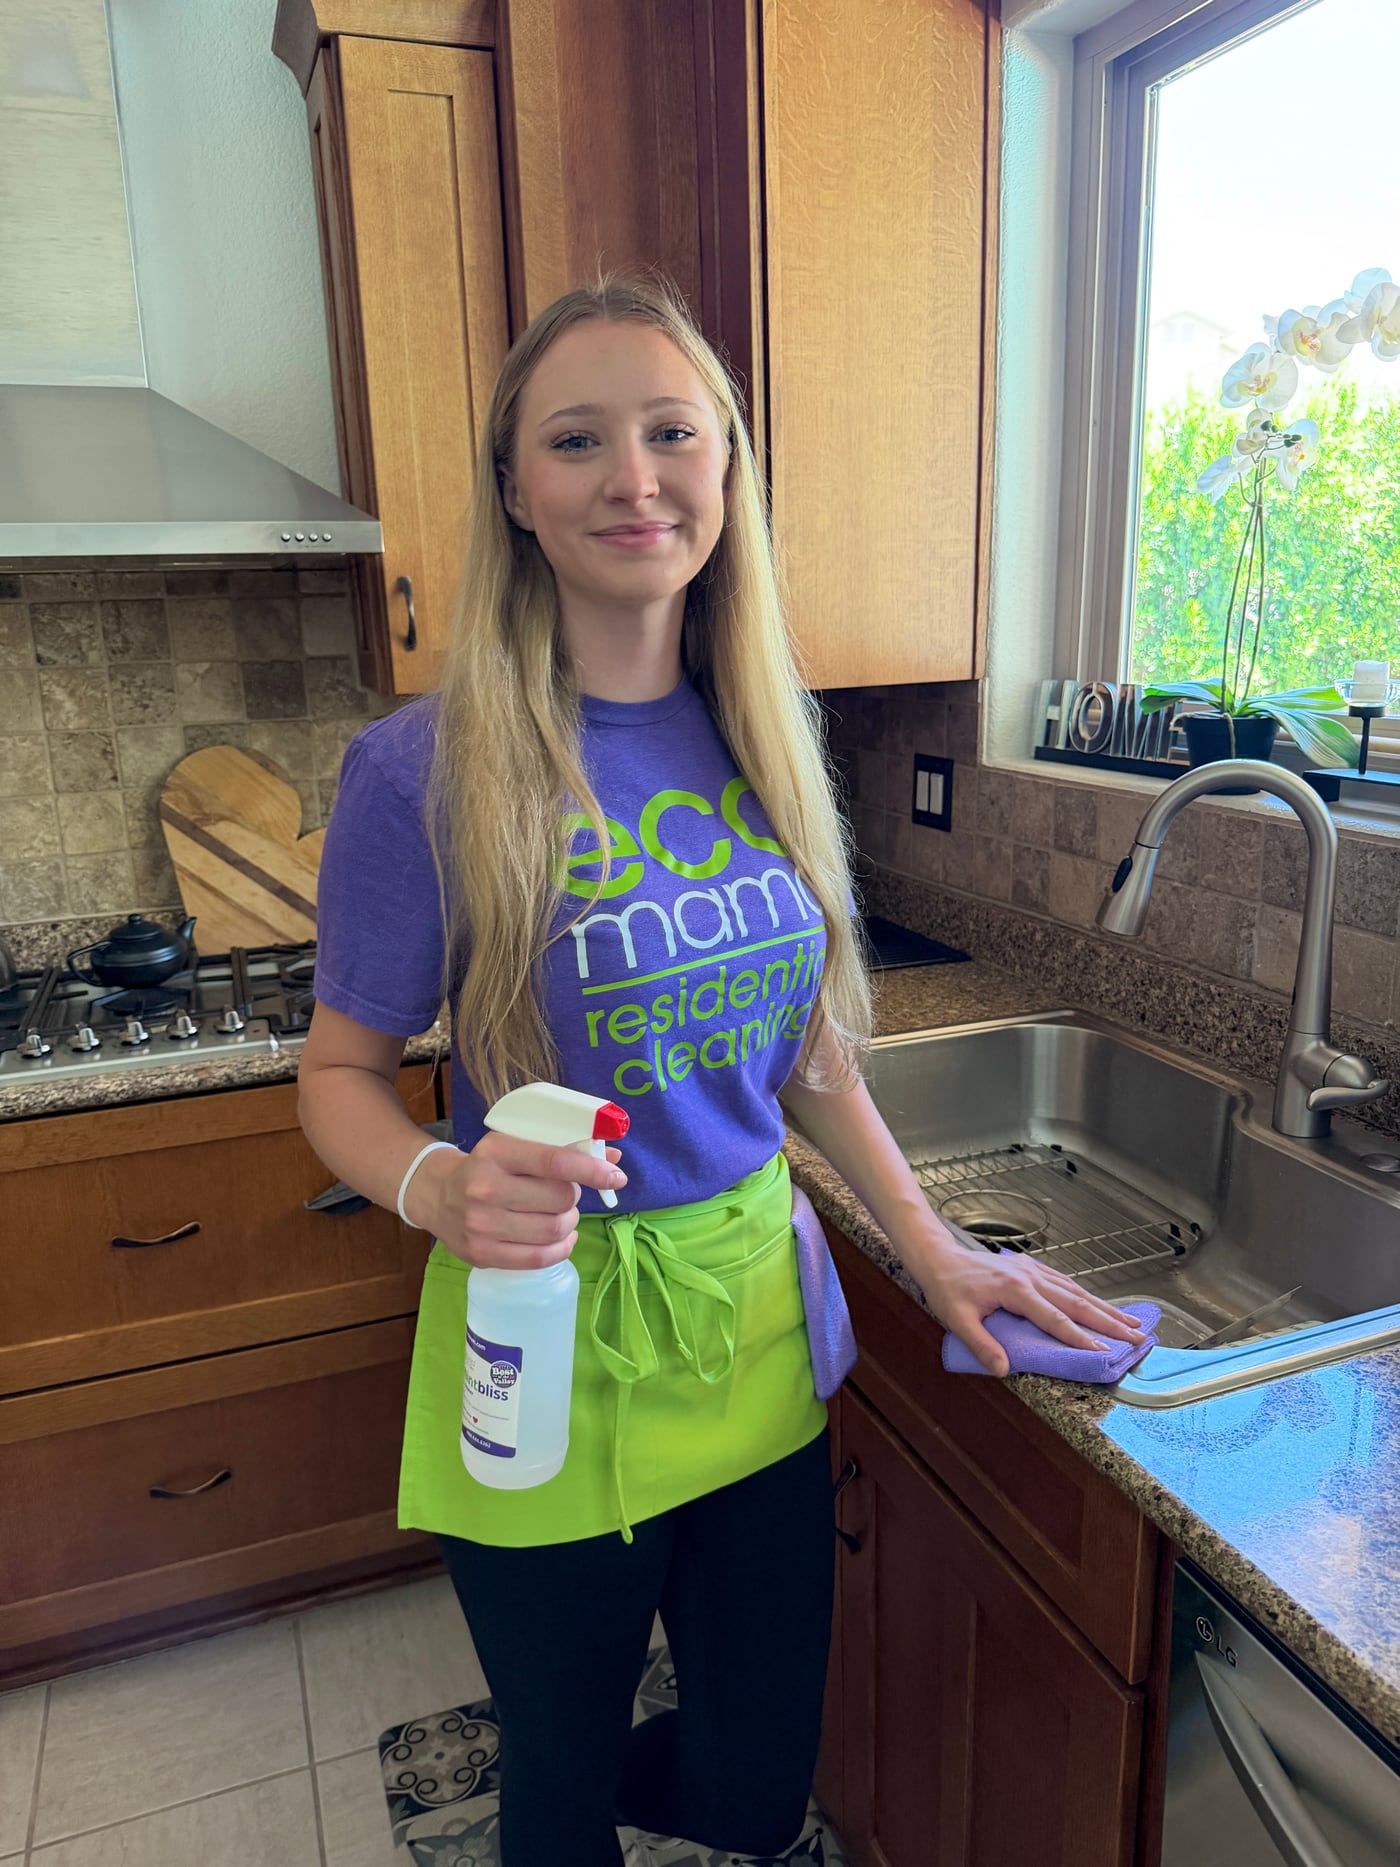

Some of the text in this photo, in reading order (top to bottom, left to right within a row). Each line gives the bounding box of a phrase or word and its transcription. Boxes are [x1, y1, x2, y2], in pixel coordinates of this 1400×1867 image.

[586, 940, 825, 1048] residenti
[492, 1367, 515, 1376] Best
[1216, 1634, 1239, 1668] LG
